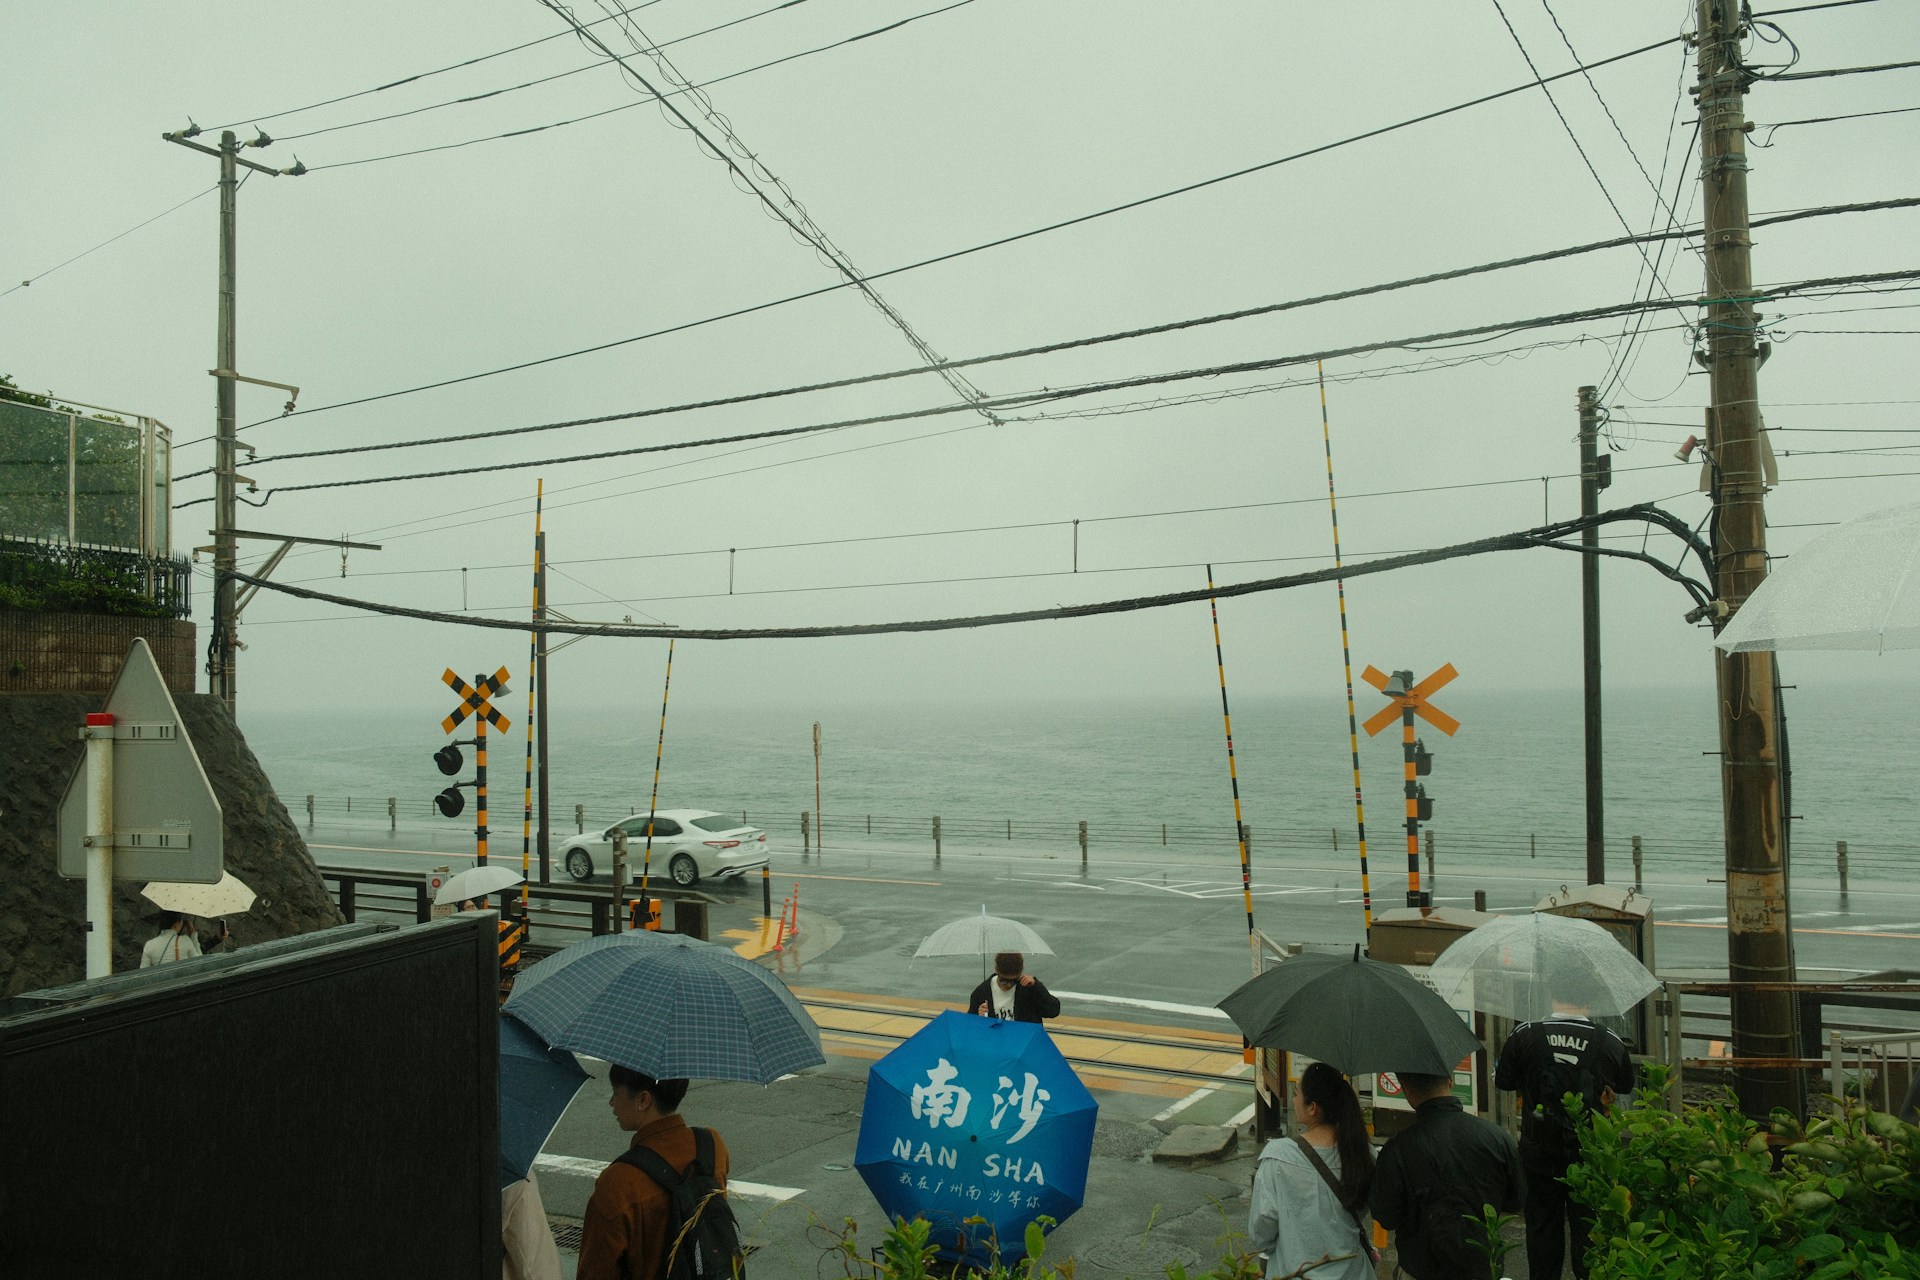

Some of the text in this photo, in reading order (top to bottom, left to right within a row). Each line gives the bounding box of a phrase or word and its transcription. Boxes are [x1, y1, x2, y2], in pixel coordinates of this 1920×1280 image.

[911, 1058, 1050, 1144] 南沙
[892, 1137, 1044, 1186] NAN SHA
[899, 1172, 1041, 1208] 我在广州南沙等你
